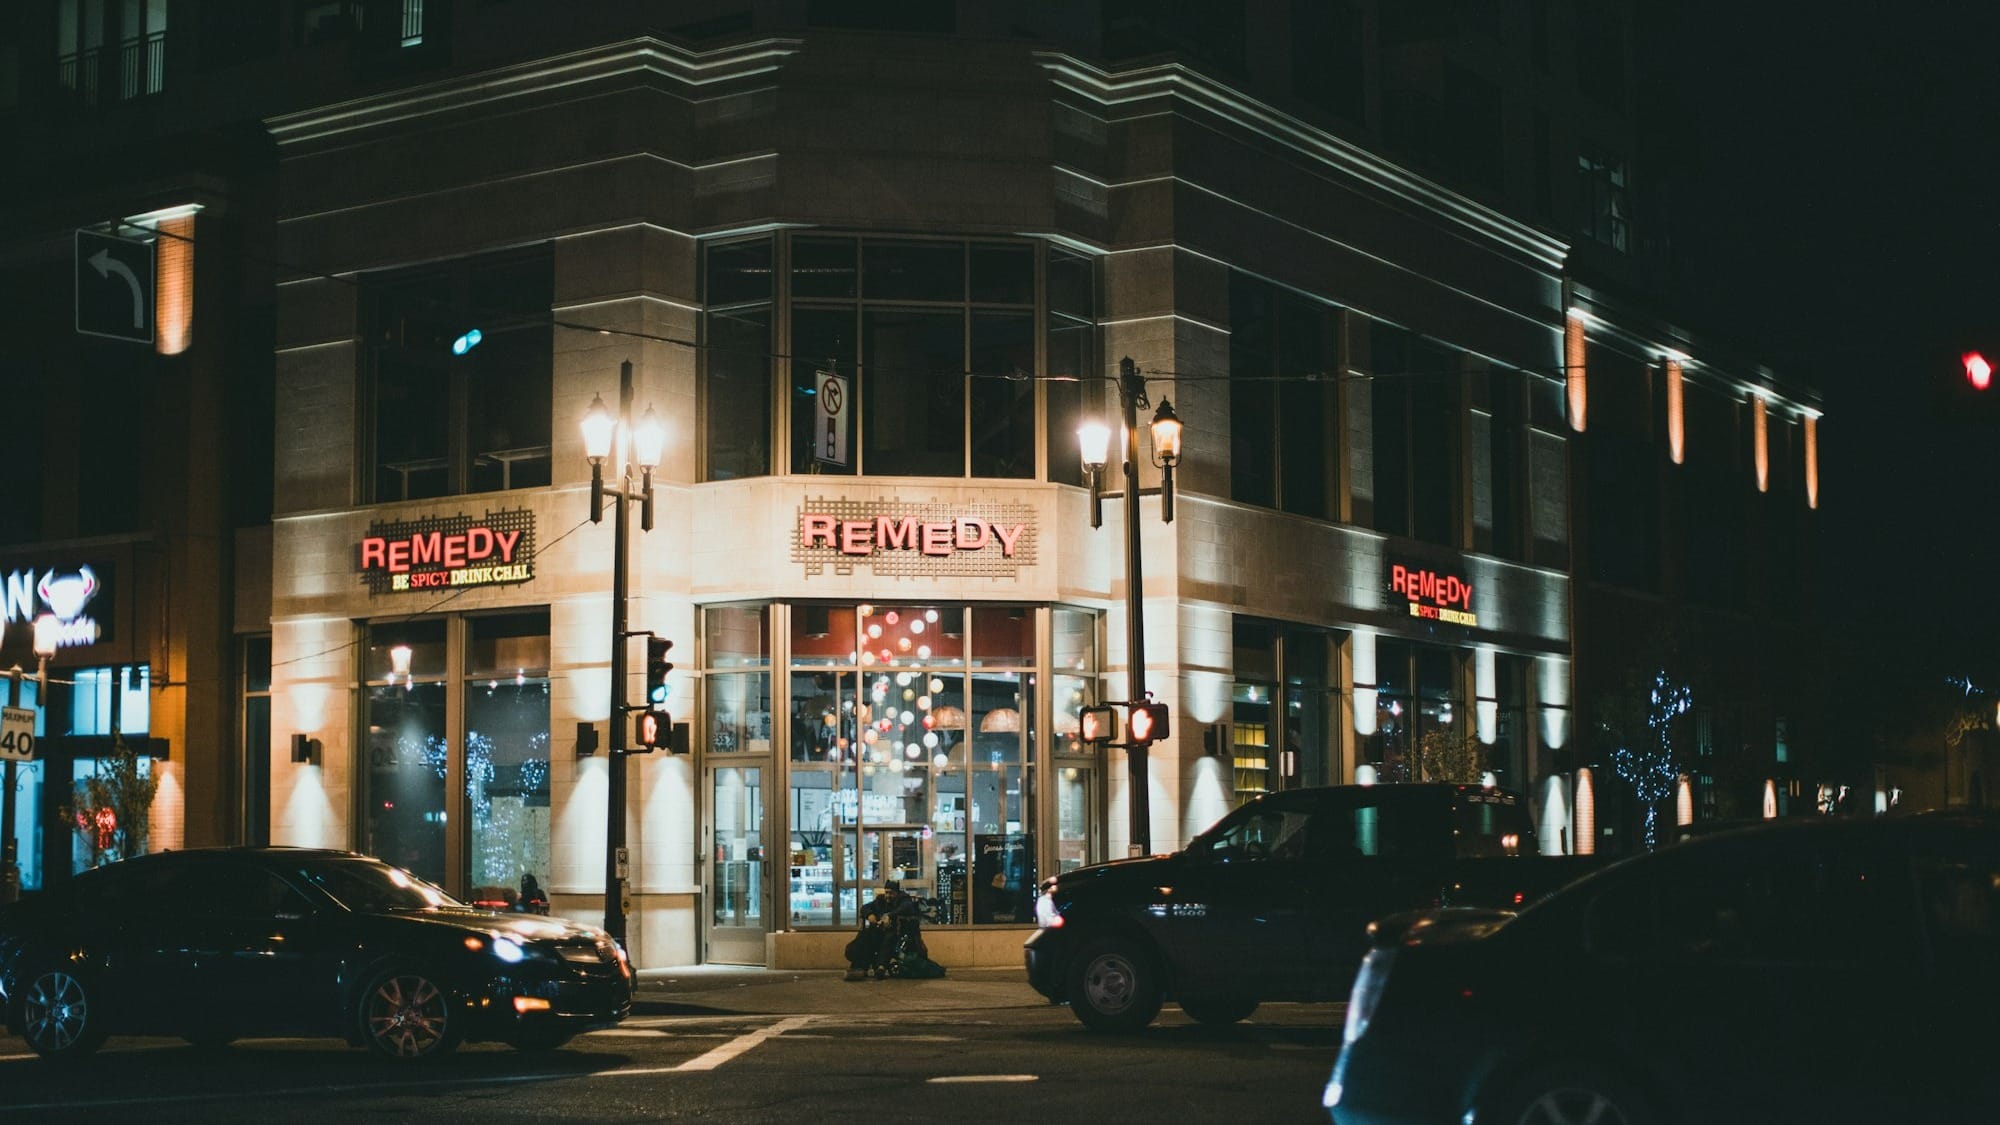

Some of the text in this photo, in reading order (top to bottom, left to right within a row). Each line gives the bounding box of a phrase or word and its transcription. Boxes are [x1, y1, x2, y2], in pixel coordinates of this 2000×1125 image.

[361, 526, 520, 572] REMEDY
[803, 513, 1024, 557] REMEDY
[392, 574, 409, 590] BE
[410, 571, 449, 588] SPICY.
[450, 567, 492, 585] DRINK
[1392, 564, 1472, 609] REMEDY
[1, 730, 32, 755] 40
